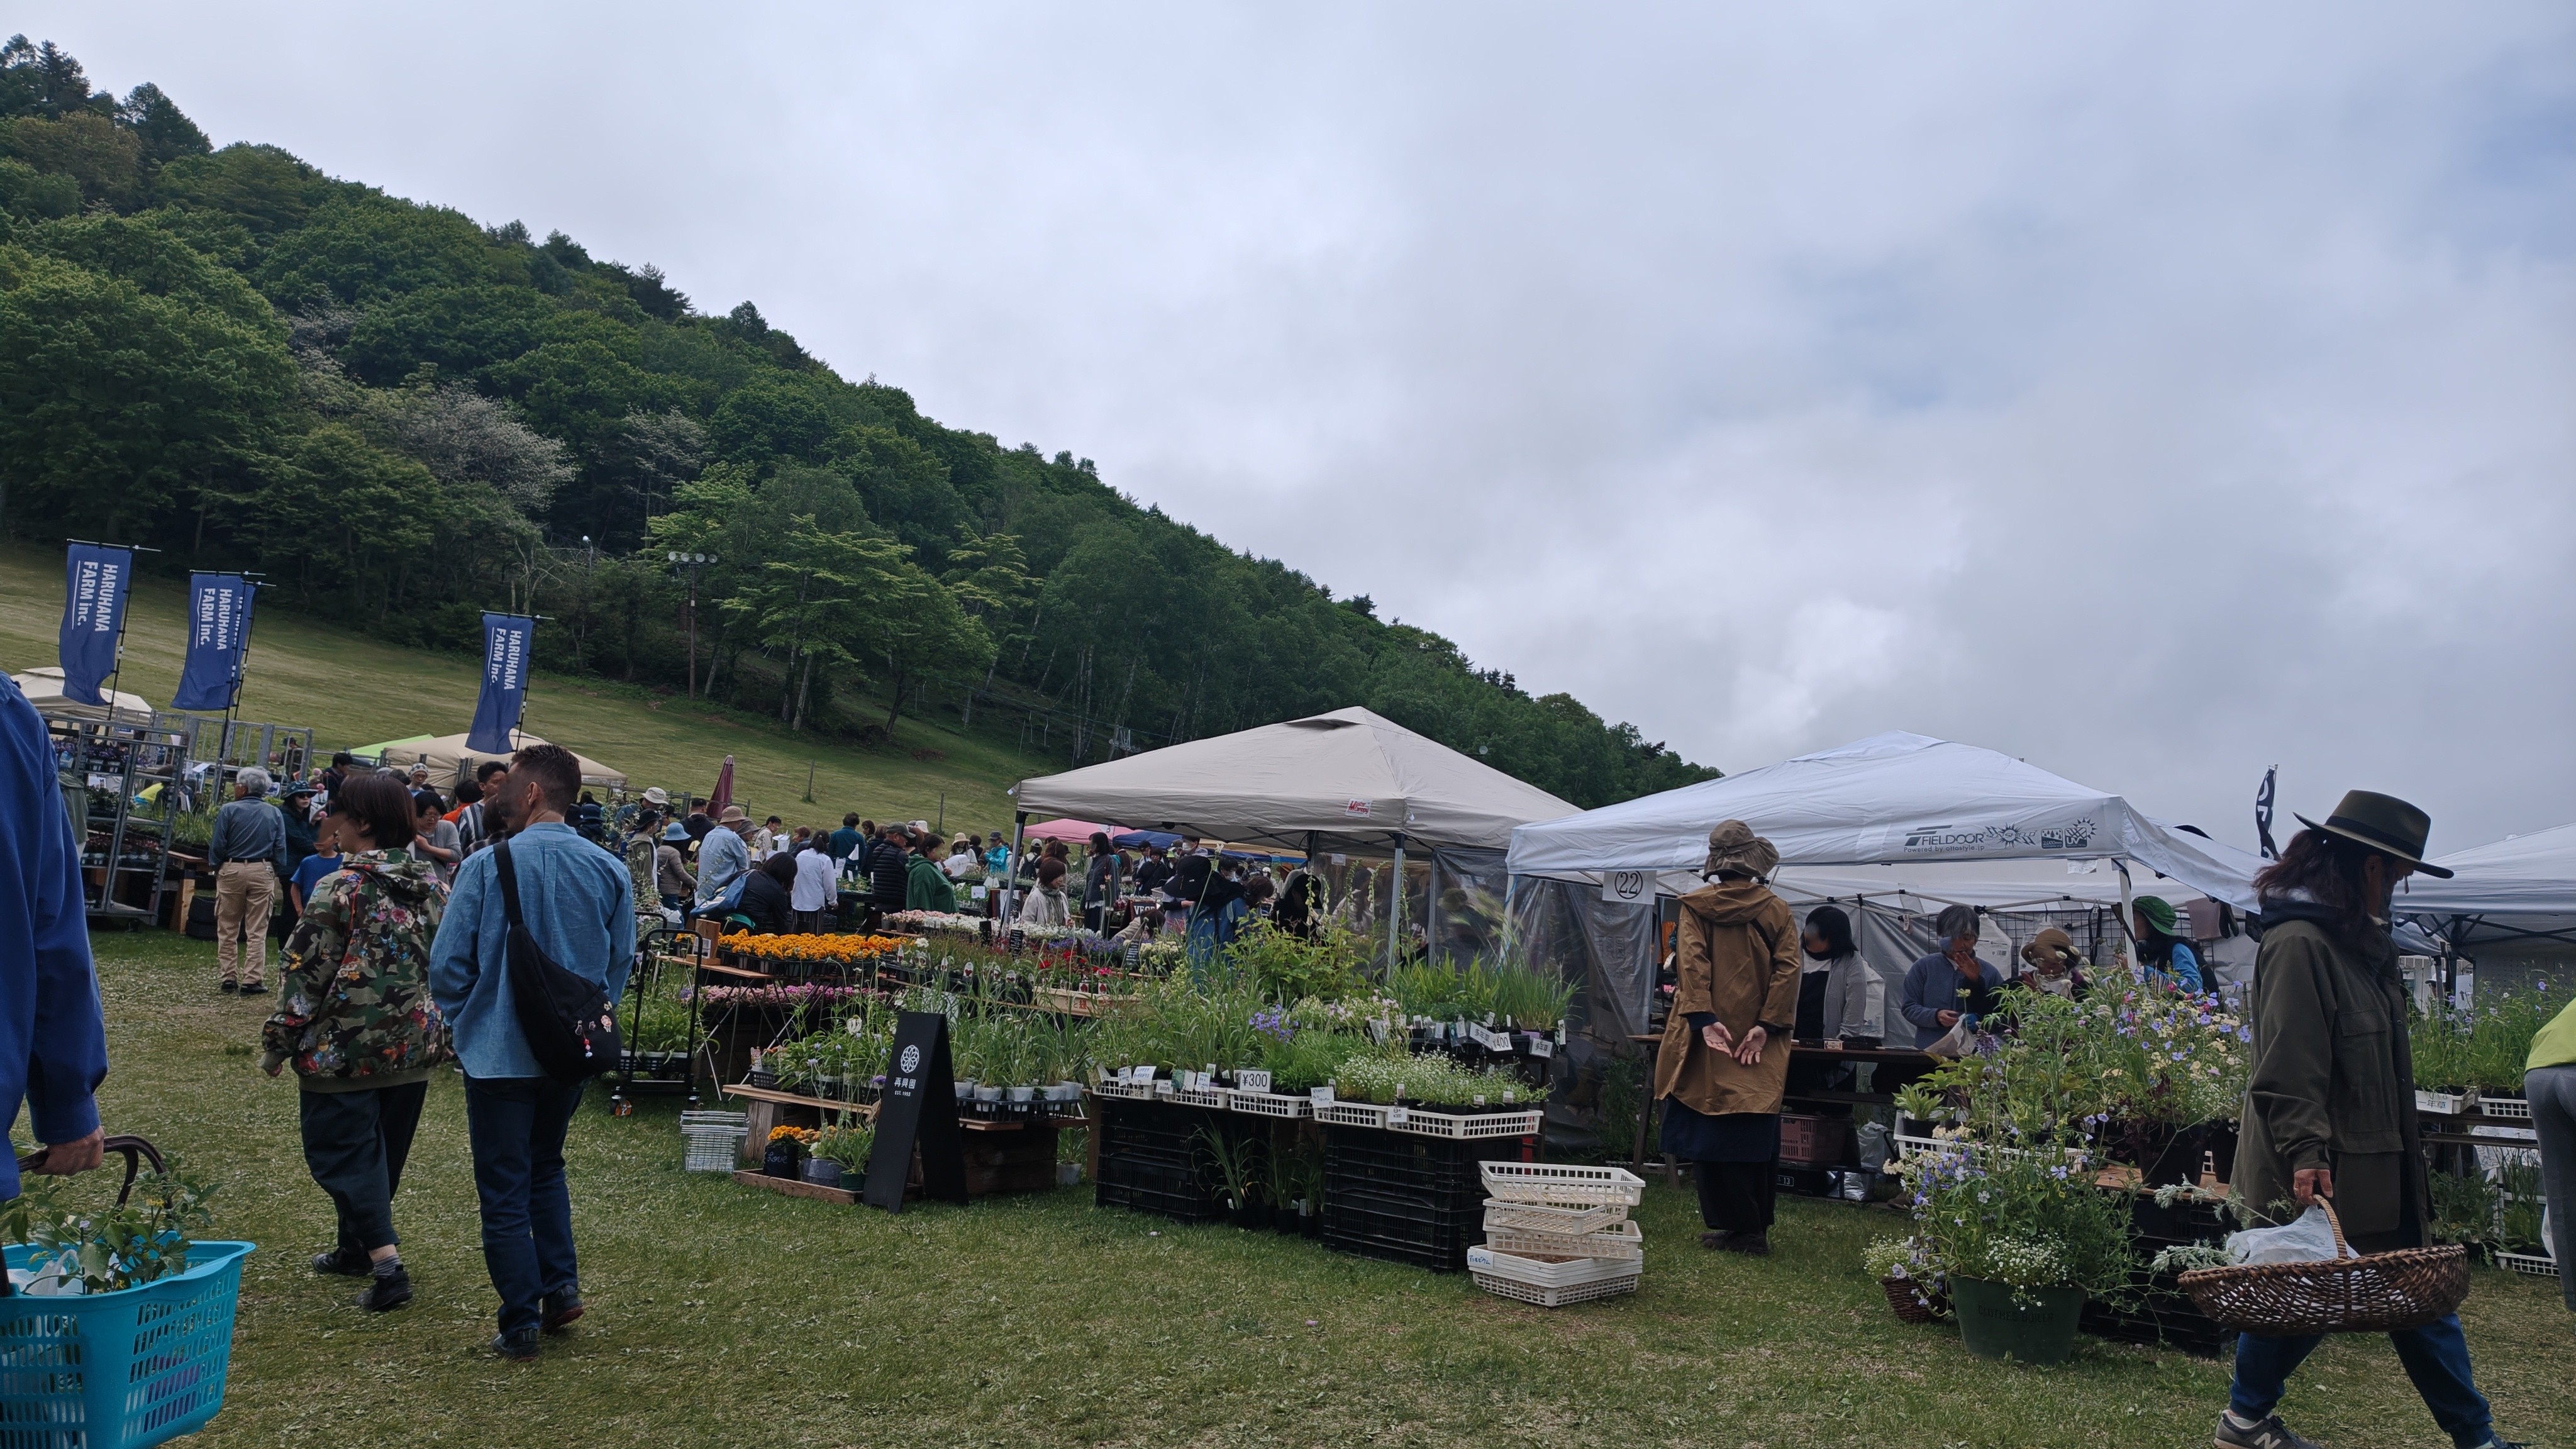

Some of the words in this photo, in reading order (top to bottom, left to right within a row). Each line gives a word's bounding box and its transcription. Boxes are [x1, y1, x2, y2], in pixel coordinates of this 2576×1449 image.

[80, 561, 98, 599] FARM
[95, 564, 118, 631] HARUHANA
[201, 588, 216, 621] FARM
[77, 602, 92, 626] inc.
[217, 589, 232, 650] HARUHANA
[201, 624, 214, 645] inc.
[493, 628, 506, 662] FARM
[491, 663, 502, 684] inc.
[504, 630, 522, 690] HARUHANA
[1921, 833, 1984, 845] FIELDOOR
[1242, 1074, 1268, 1087] ¥300
[2253, 1432, 2282, 1449] N
